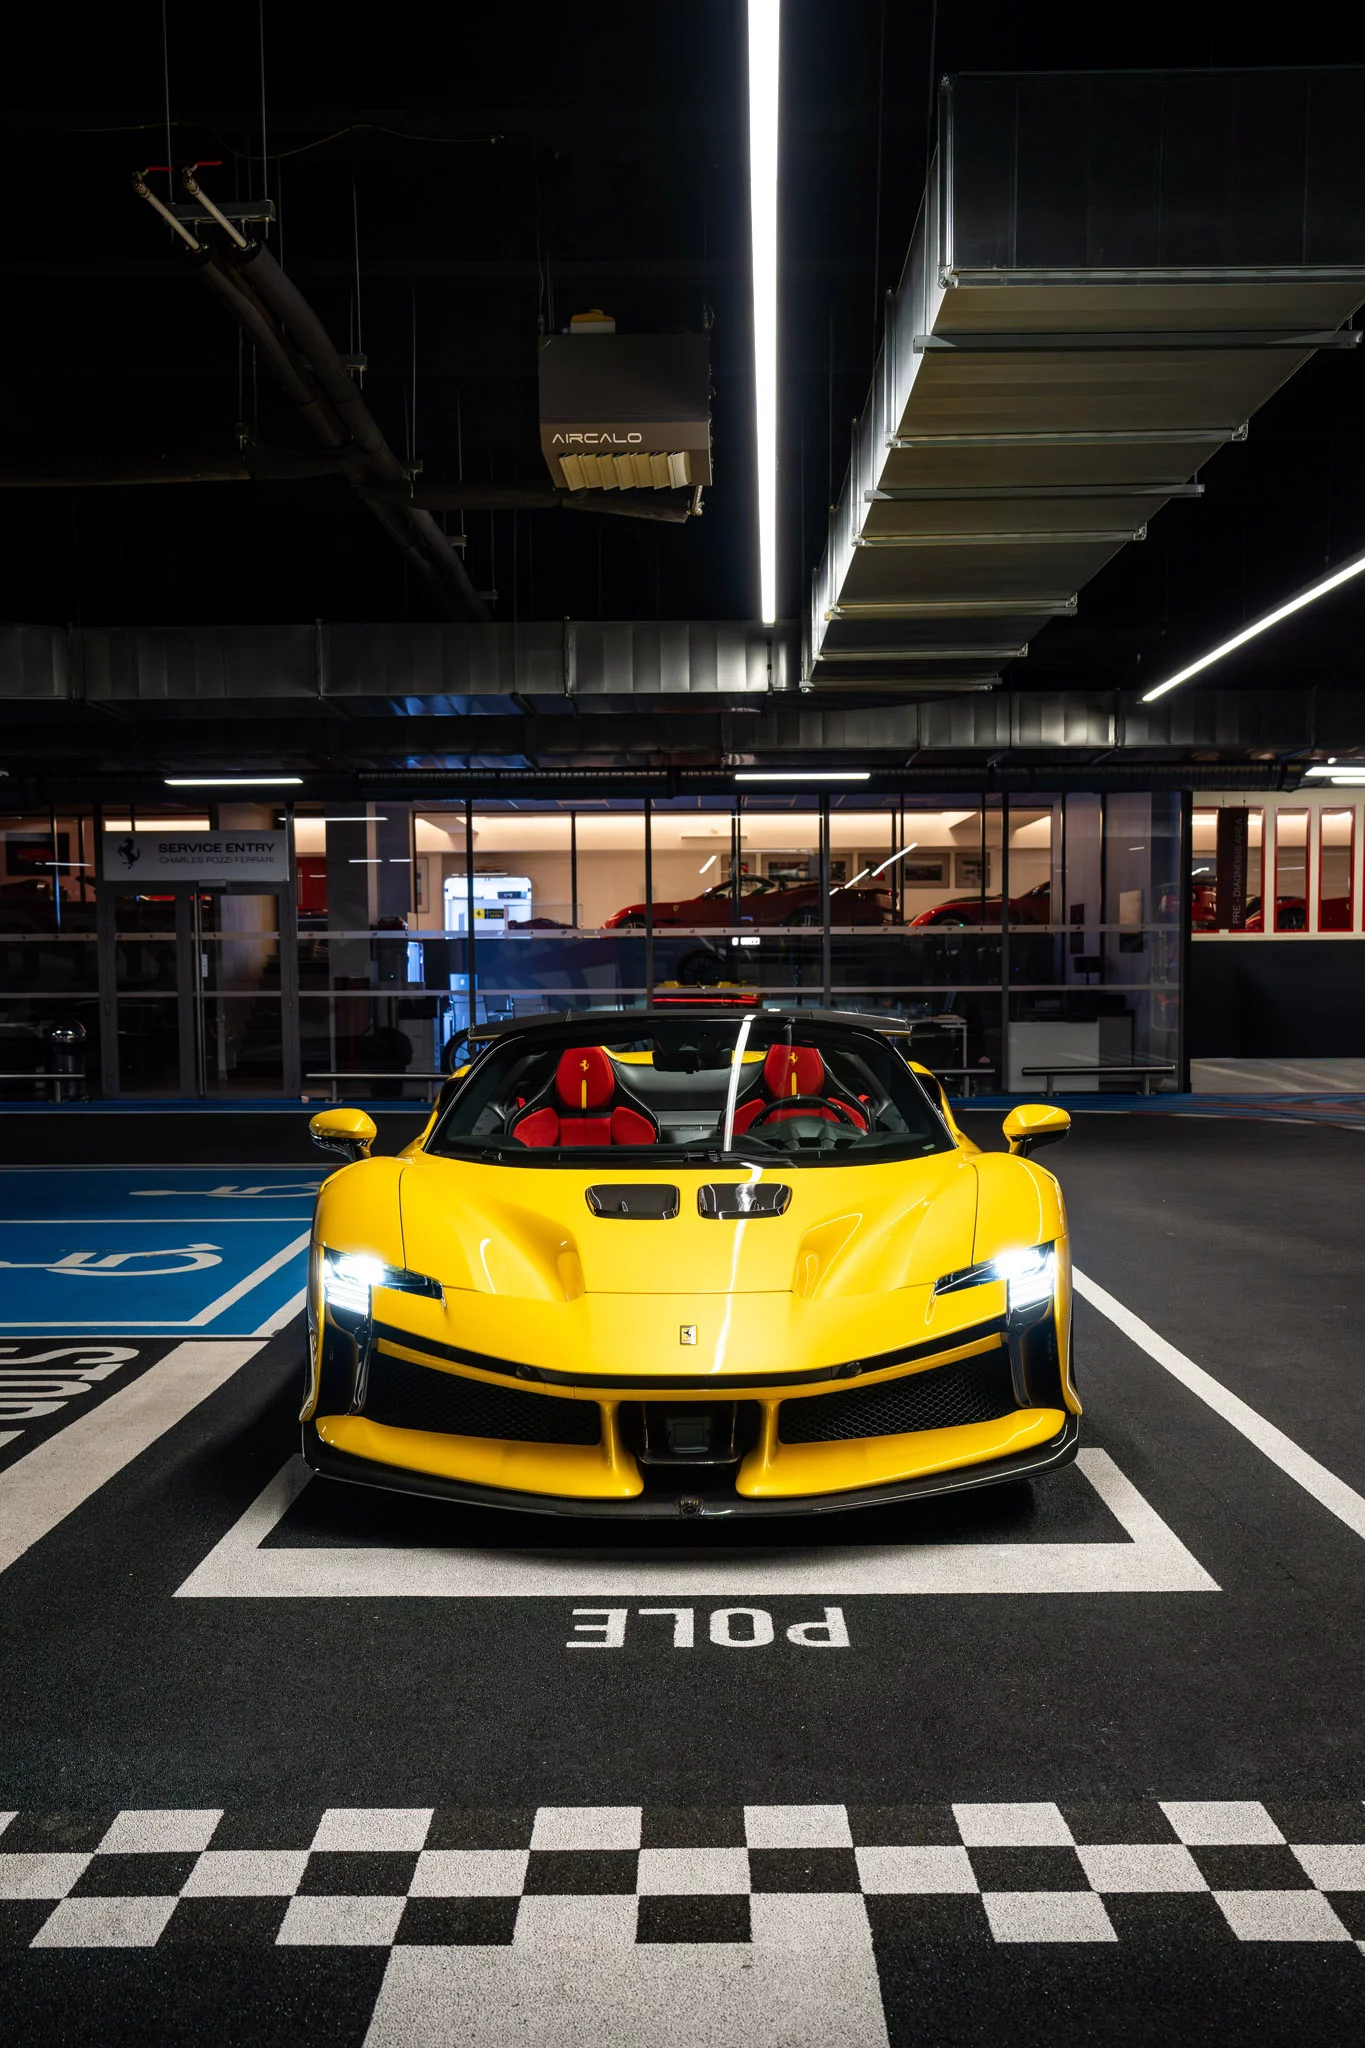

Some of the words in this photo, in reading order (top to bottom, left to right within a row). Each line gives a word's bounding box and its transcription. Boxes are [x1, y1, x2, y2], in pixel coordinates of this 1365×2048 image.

[552, 433, 642, 443] AIRCALO
[158, 843, 222, 853] SERVICE
[225, 843, 275, 853] ENTRY
[1232, 904, 1241, 924] PRE
[566, 1607, 851, 1648] POLE
